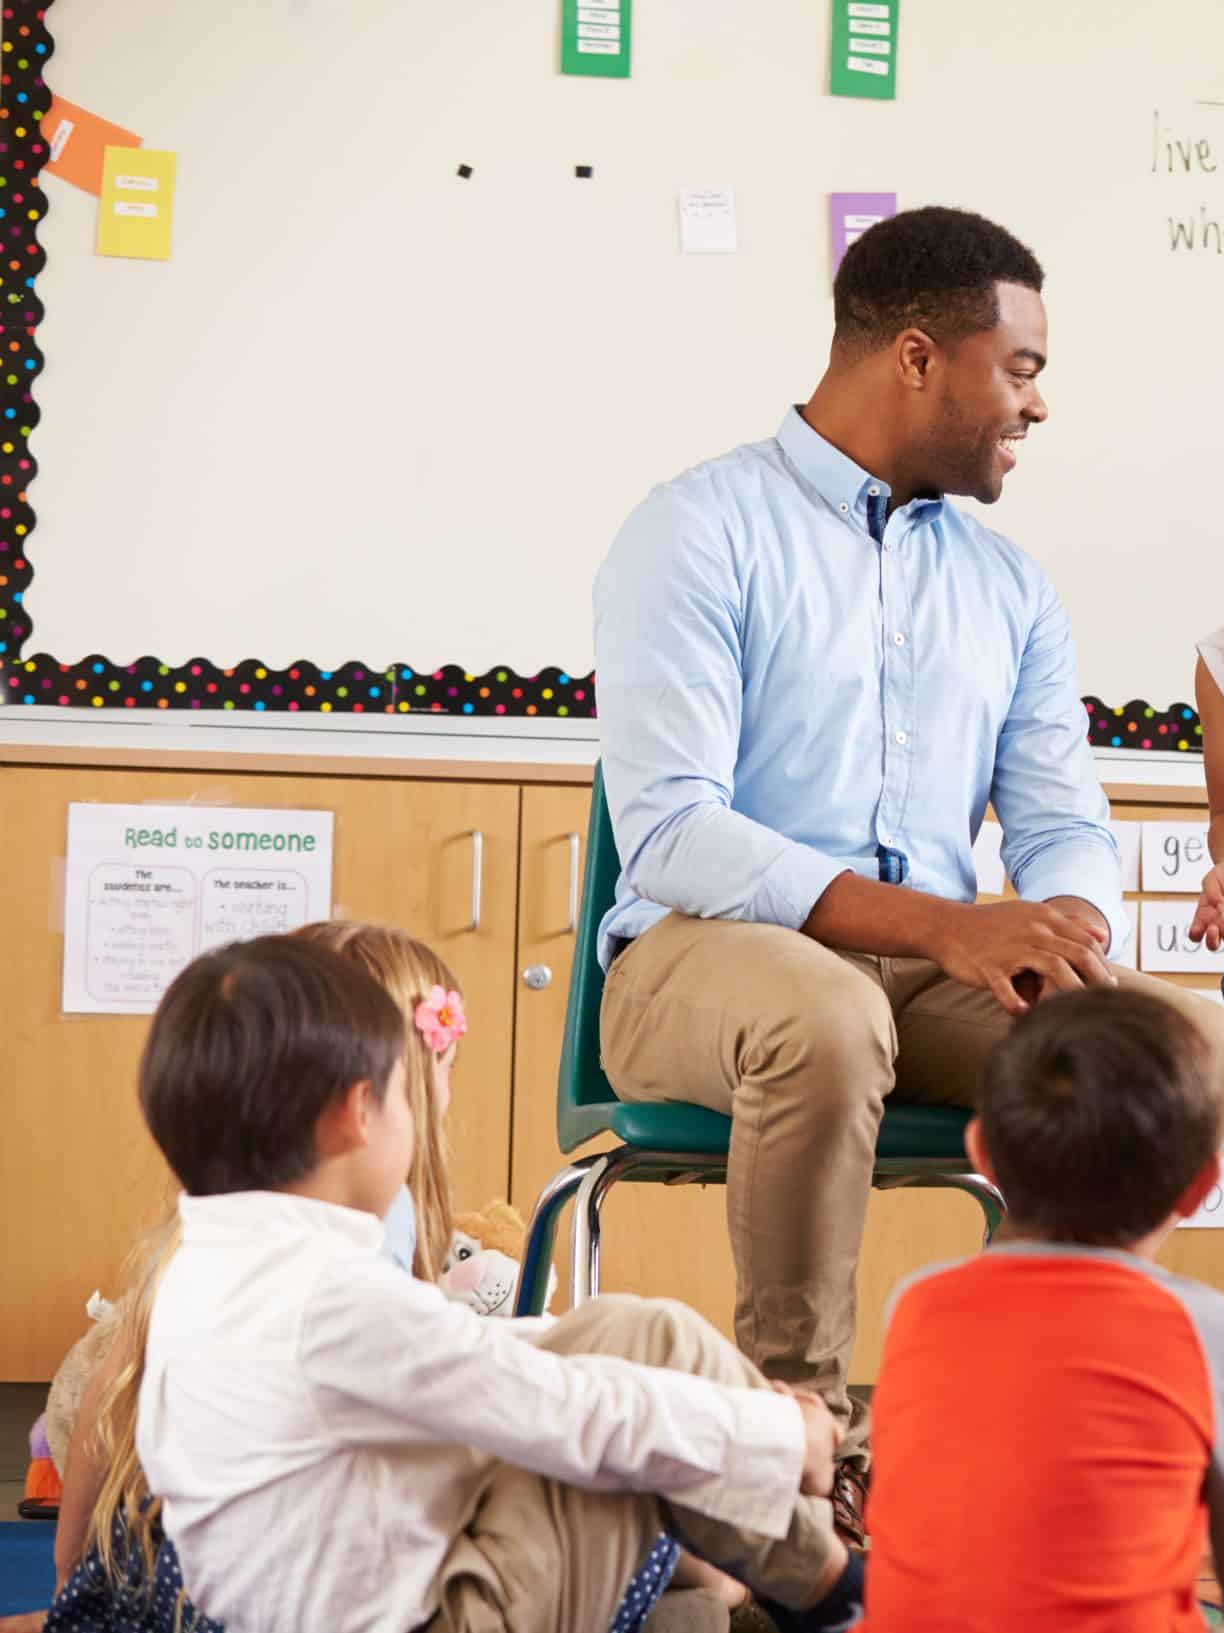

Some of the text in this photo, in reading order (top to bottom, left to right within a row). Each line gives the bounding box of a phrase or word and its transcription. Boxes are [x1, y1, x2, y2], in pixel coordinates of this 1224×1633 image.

[1151, 109, 1217, 174] live
[124, 827, 315, 852] Read to someone
